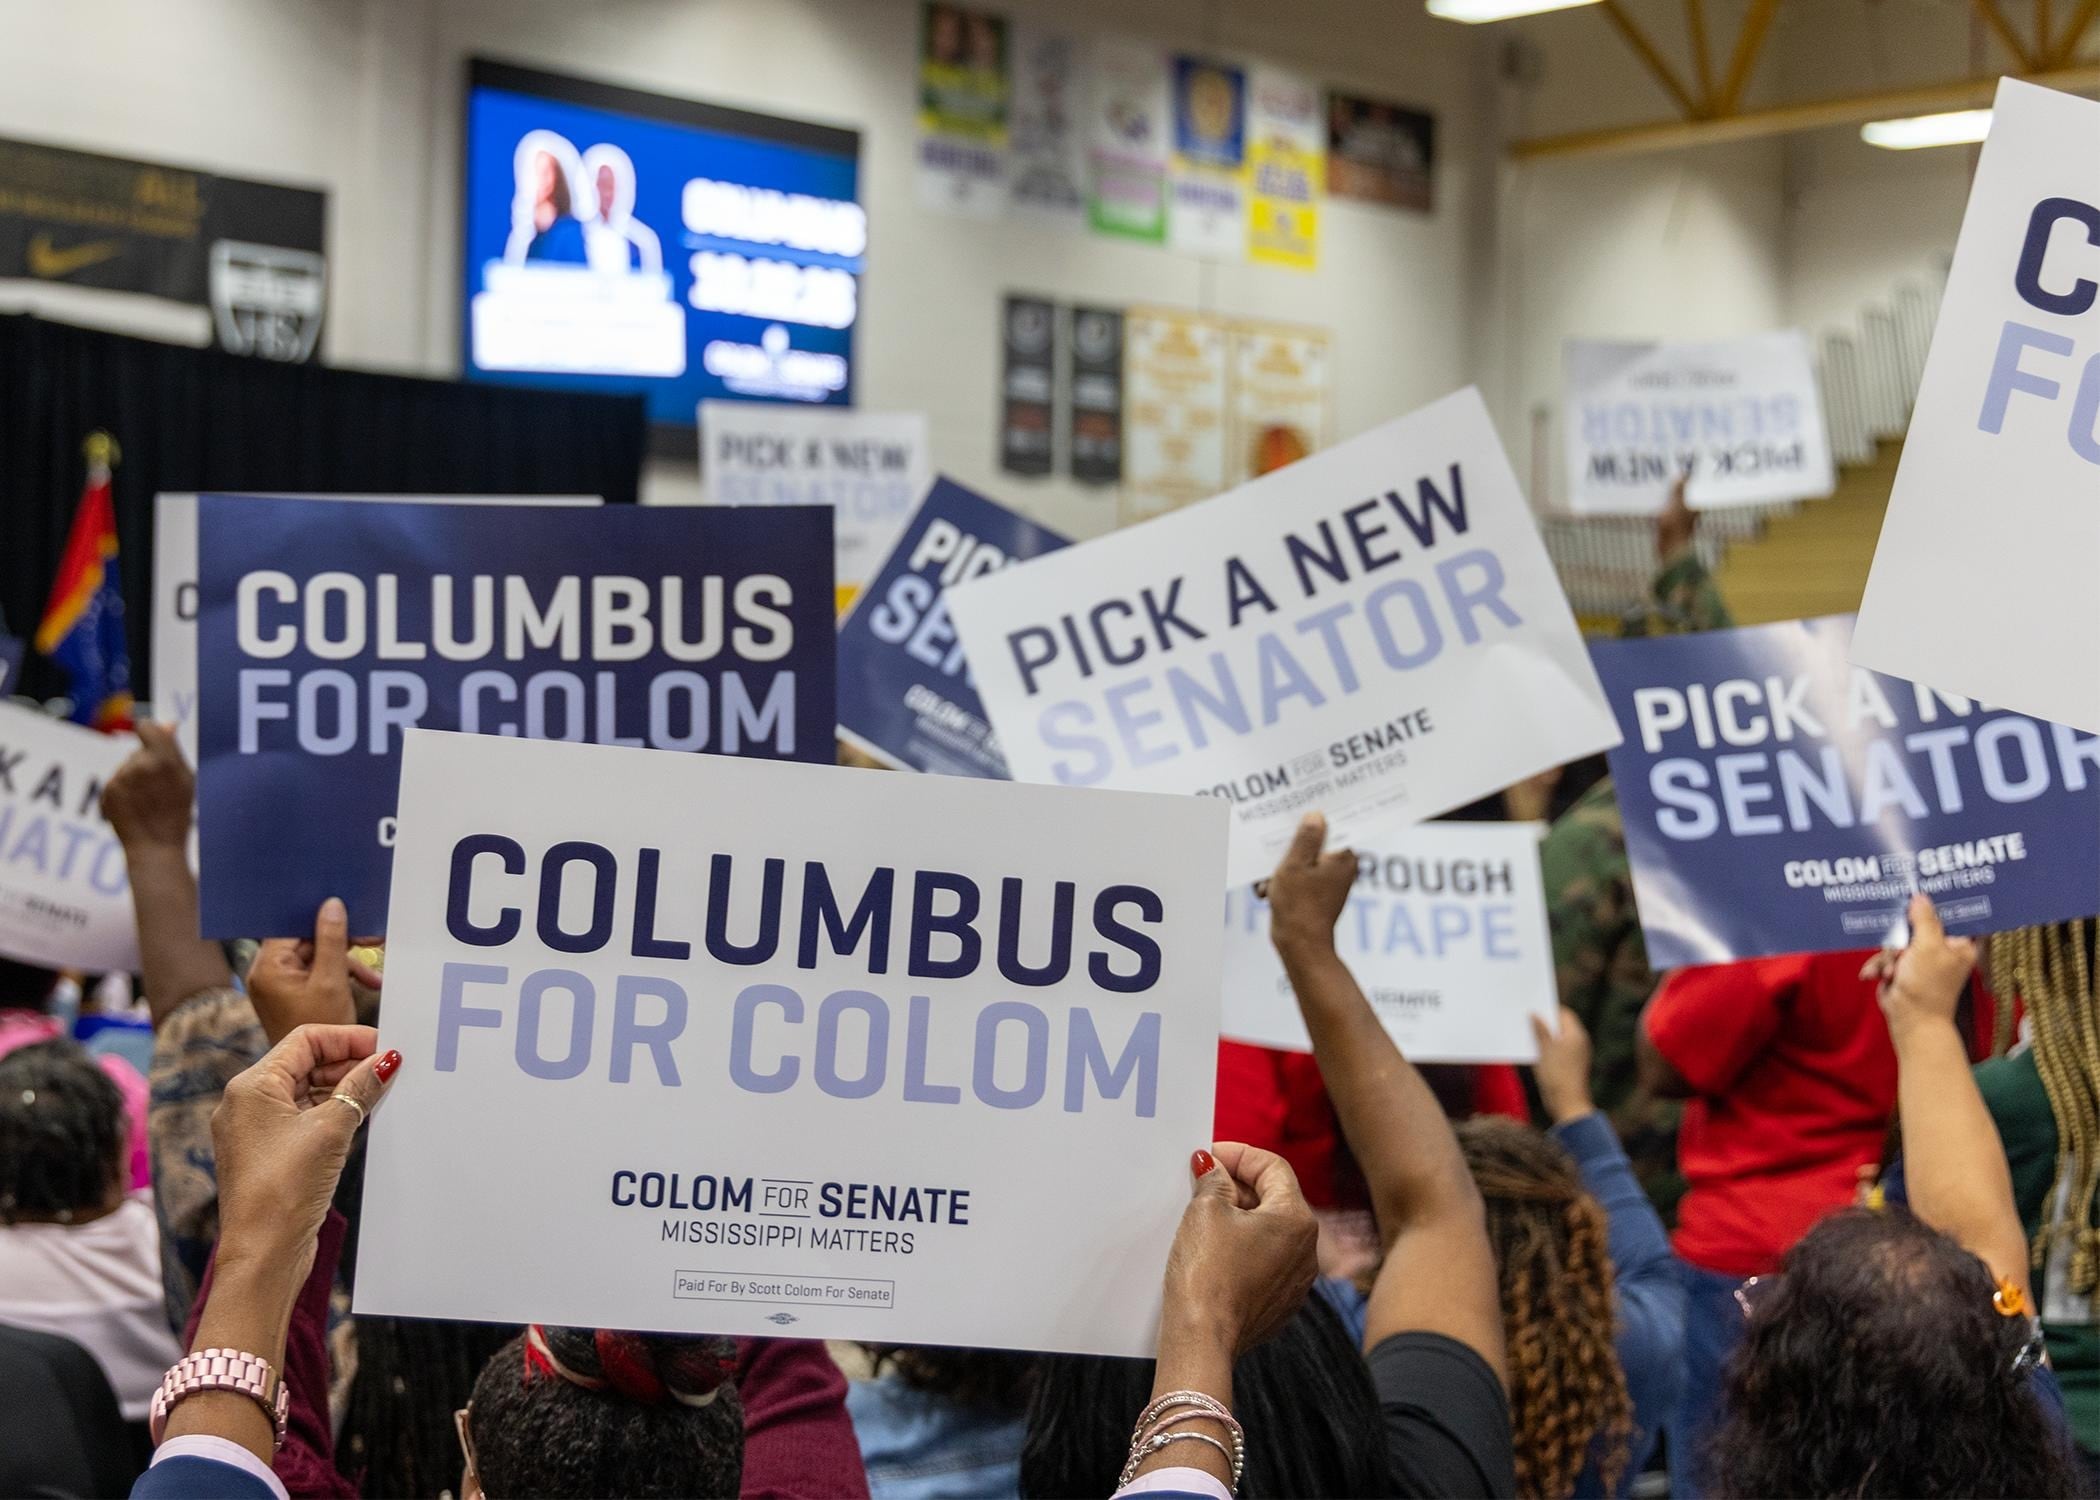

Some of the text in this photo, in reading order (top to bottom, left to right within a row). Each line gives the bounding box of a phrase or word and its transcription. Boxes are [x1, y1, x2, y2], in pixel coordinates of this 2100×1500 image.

[908, 517, 1020, 586] PIC
[1007, 461, 1470, 697] PICK A NEW
[237, 570, 795, 663] COLUMBUS
[1036, 547, 1525, 787] SENATOR
[238, 668, 796, 756] FOR COLOM
[1328, 706, 1435, 768] SENATE
[1632, 673, 1828, 755] PICK
[32, 763, 64, 808] A
[1334, 751, 1409, 790] MATTERS
[0, 804, 129, 897] ATO
[1783, 855, 1882, 889] COLOM
[1917, 831, 2028, 877] SENATE
[1918, 864, 1996, 896] MATTERS
[444, 832, 1164, 993] COLUMBUS
[1348, 894, 1523, 961] TAPE
[432, 961, 1162, 1118] FOR COLOM
[610, 1169, 971, 1226] COLOM FOR SENATE
[660, 1219, 915, 1255] MISSISSIPPI MATTERS
[678, 1278, 890, 1301] Paid For By Scott Colom For Senate
